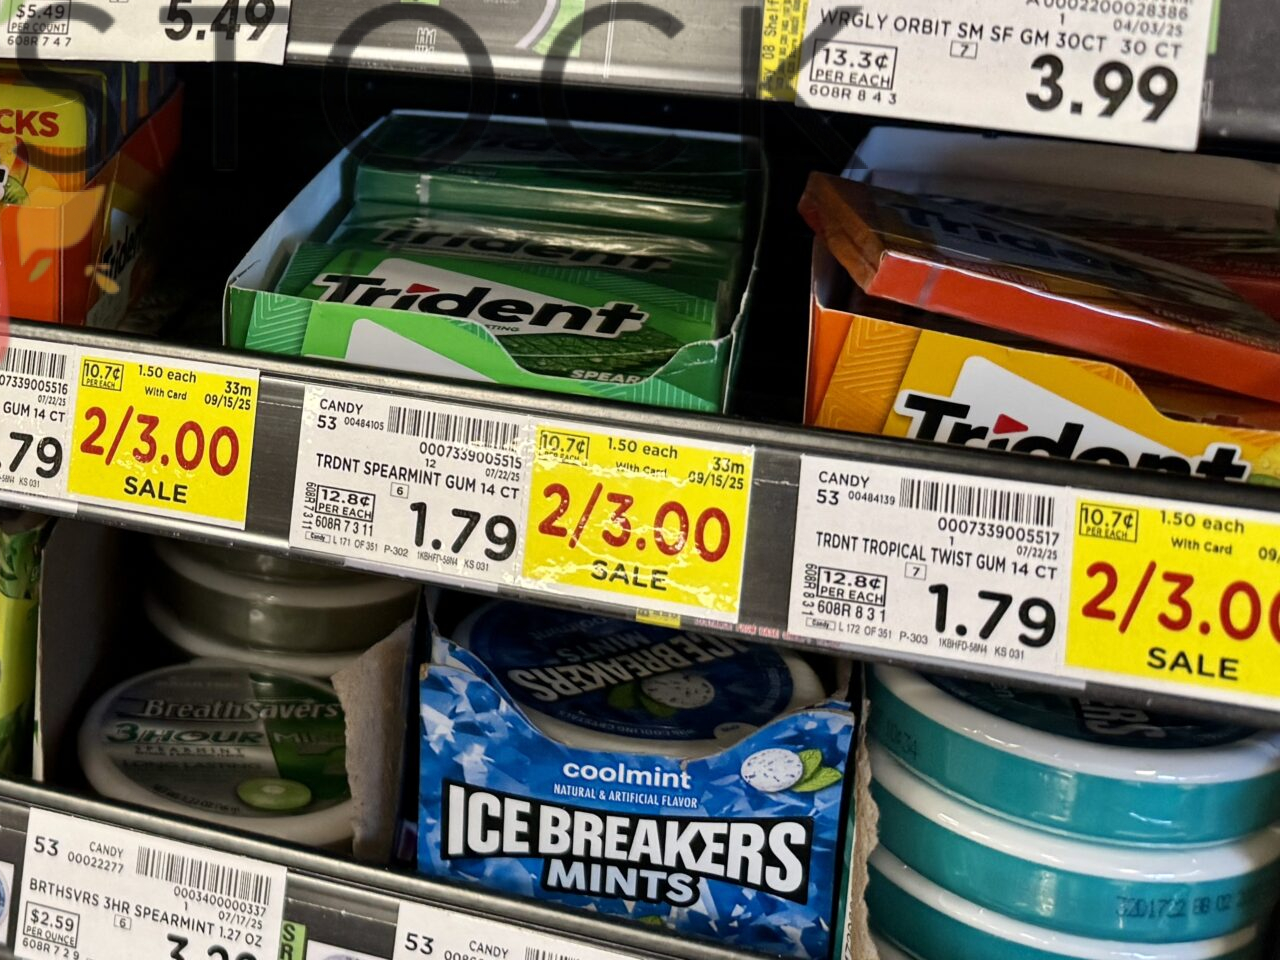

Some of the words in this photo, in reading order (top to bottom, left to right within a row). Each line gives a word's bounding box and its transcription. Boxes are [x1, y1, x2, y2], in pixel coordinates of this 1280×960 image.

[820, 9, 888, 31] WRGLY
[894, 16, 951, 37] ORBIT
[957, 23, 983, 39] SM
[991, 26, 1013, 42] SF
[1021, 29, 1049, 45] GM
[1056, 32, 1106, 52] 30CT
[1121, 38, 1145, 56] 30
[1156, 41, 1182, 58] CT
[1026, 54, 1179, 123] 3.99
[321, 273, 645, 337] Trident
[138, 364, 163, 378] 1.50
[167, 370, 197, 384] each
[145, 386, 165, 397] With
[166, 389, 187, 400] Card
[3, 403, 30, 417] GUM
[34, 407, 46, 419] 14
[50, 410, 66, 423] CT
[204, 395, 251, 410] 09/15/25
[81, 406, 239, 476] 2/3.00
[124, 476, 188, 504] SALE
[410, 501, 517, 561] 1.79
[538, 482, 731, 562] 2/3.00
[591, 560, 667, 591] SALE
[929, 584, 1055, 647] 1.79
[1081, 561, 1280, 644] 2/3.0
[1147, 647, 1239, 680] SALE
[554, 784, 596, 798] NATURAL
[599, 790, 606, 800] &
[609, 792, 659, 805] ARTIFICIAL
[661, 794, 697, 808] FLAVOR
[563, 762, 691, 789] coolmint
[449, 786, 531, 854] ICE
[539, 805, 806, 892] BREAKERS
[548, 859, 693, 901] MINTS
[30, 878, 100, 905] BRTHSVRS
[104, 897, 131, 913] 3HR
[134, 904, 214, 936] SPEARMINT
[219, 926, 242, 941] 1.27
[245, 932, 262, 947] OZ
